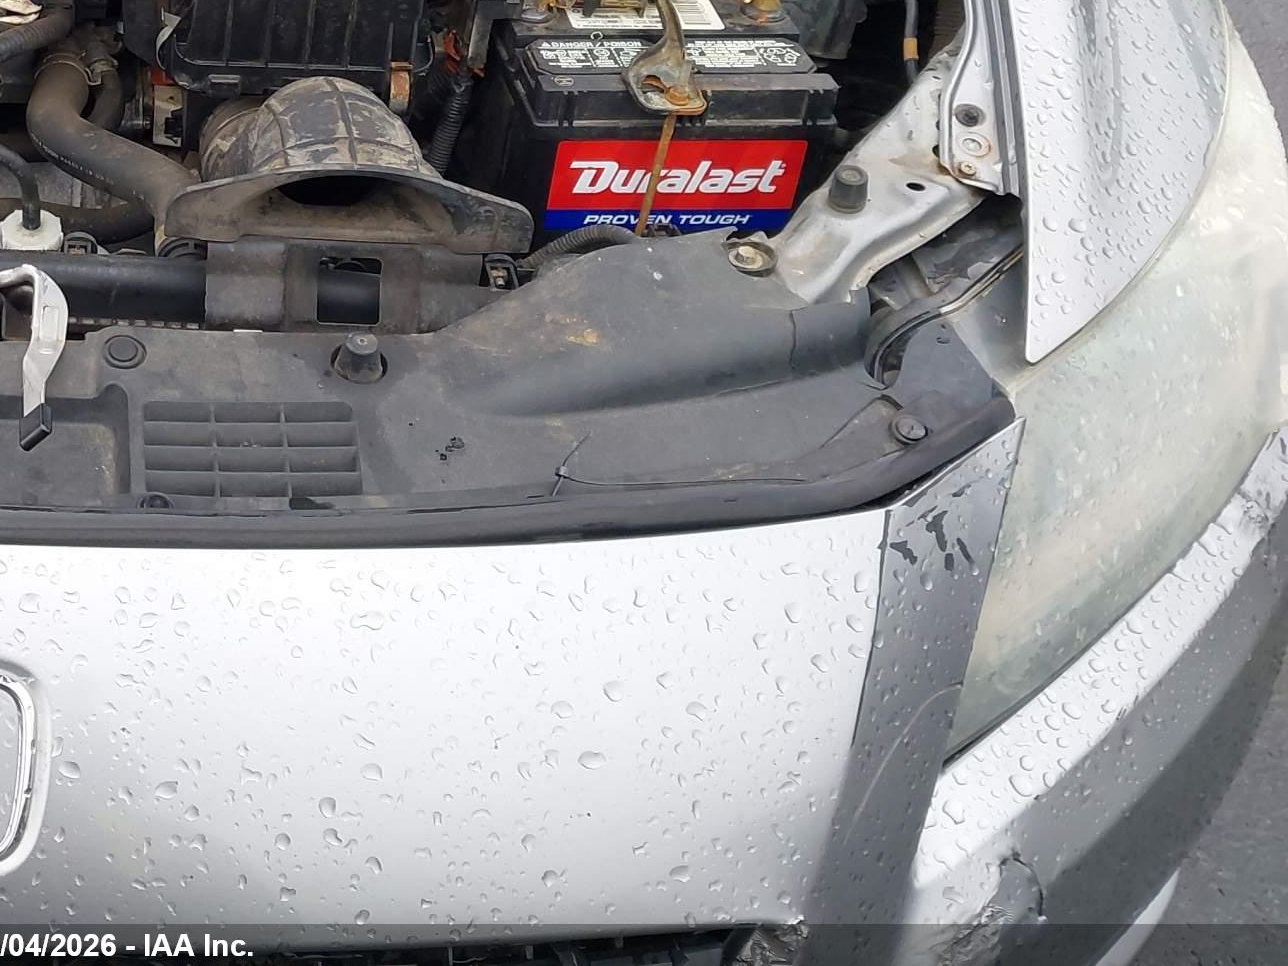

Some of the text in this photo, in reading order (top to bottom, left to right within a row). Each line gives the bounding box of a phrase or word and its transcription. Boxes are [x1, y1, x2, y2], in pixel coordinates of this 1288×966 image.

[570, 160, 785, 194] Duralast
[583, 214, 749, 225] PROVEN TOUGH
